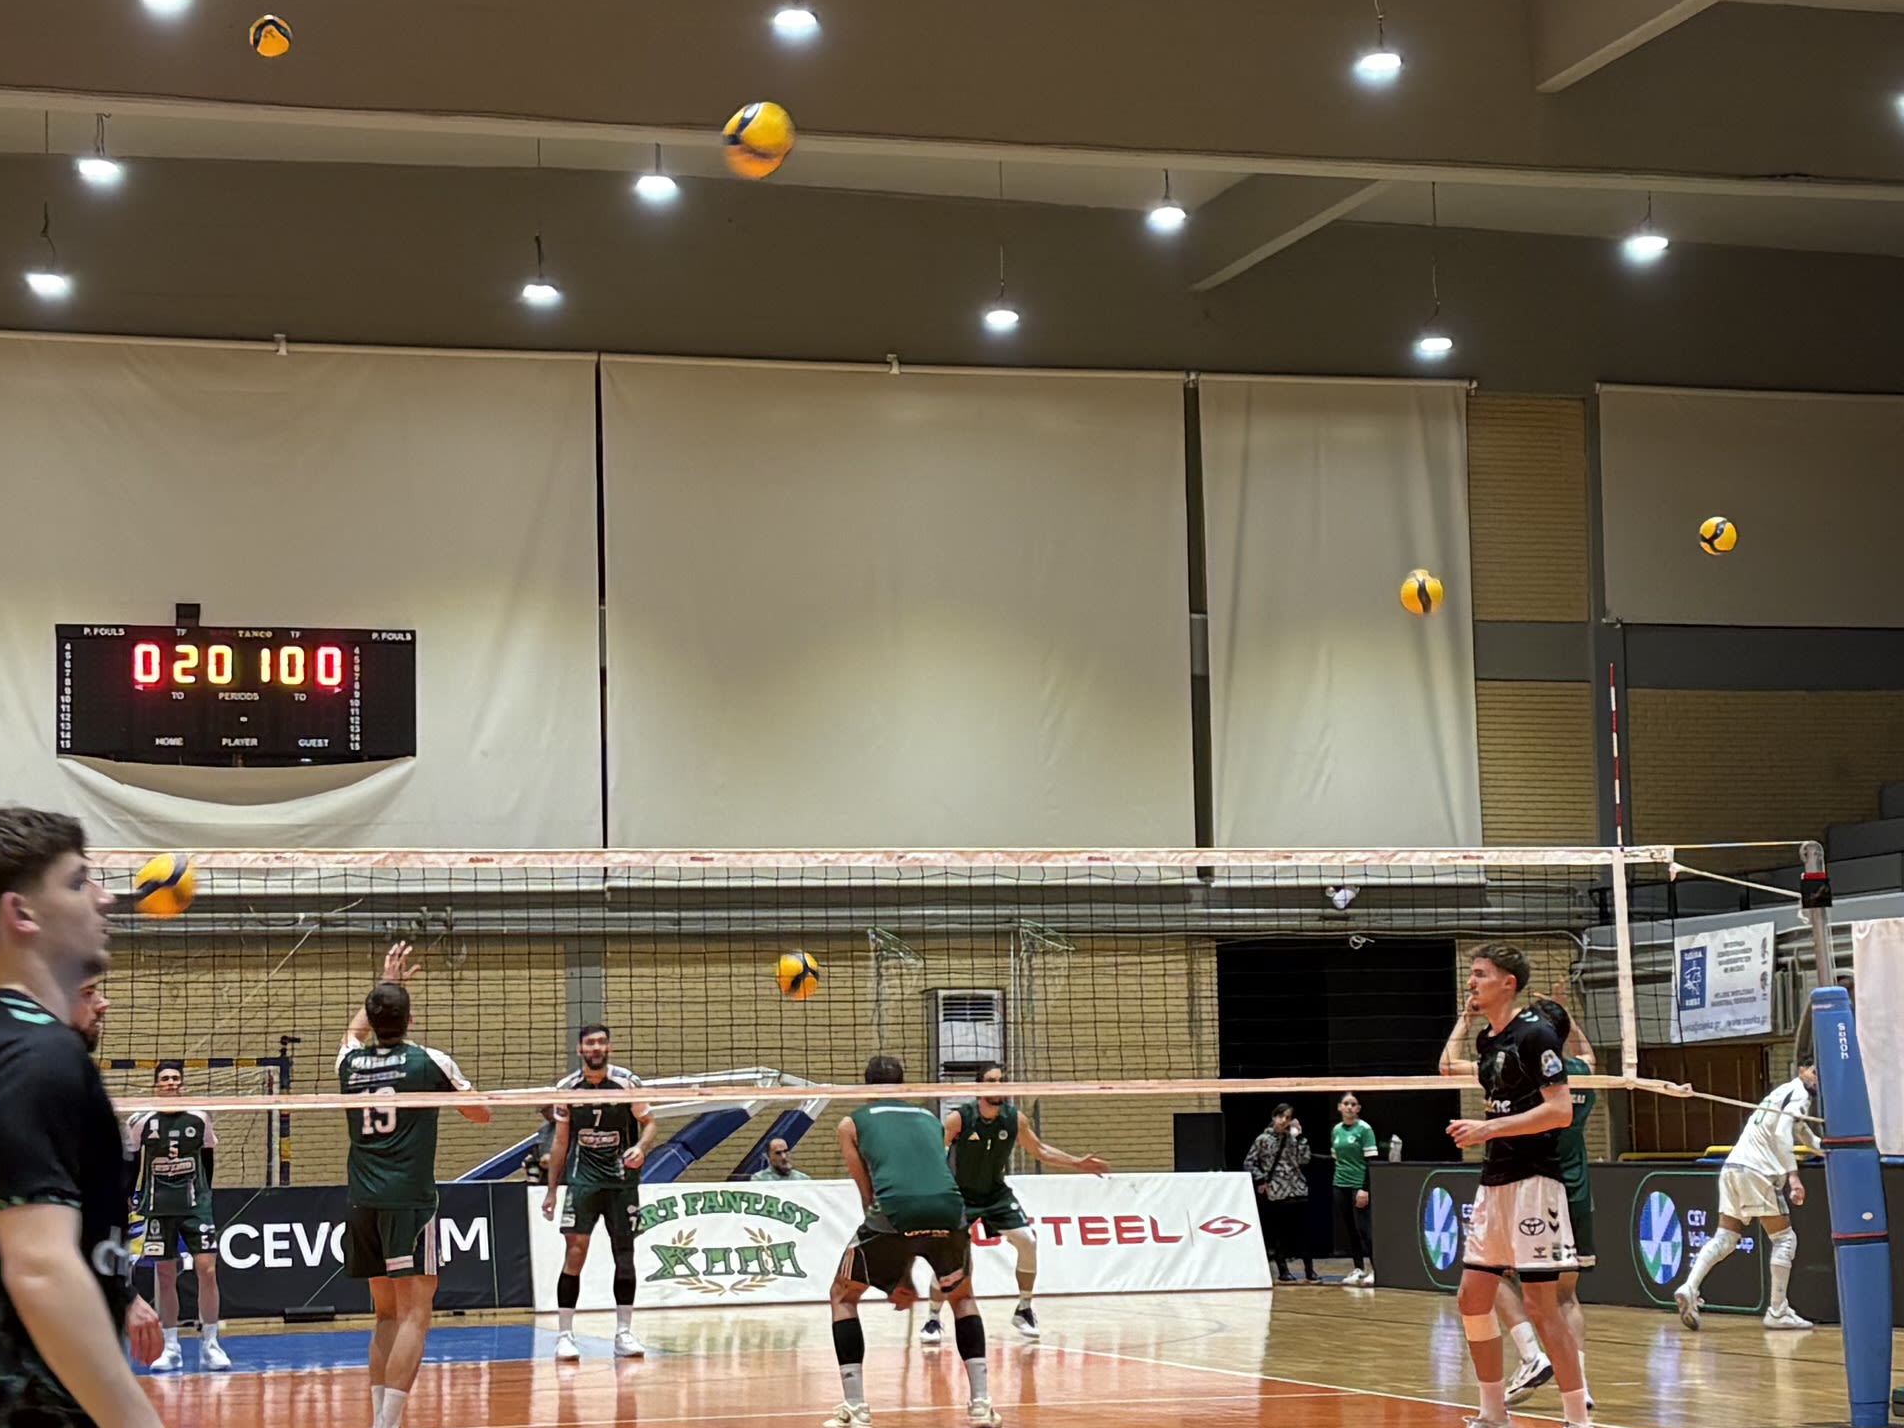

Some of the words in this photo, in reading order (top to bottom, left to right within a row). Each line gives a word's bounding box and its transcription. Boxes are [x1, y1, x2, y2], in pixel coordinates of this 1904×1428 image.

[221, 738, 258, 747] PLAYER
[592, 1109, 602, 1127] 7
[637, 1196, 679, 1232] RT
[681, 1190, 821, 1234] FANTASY
